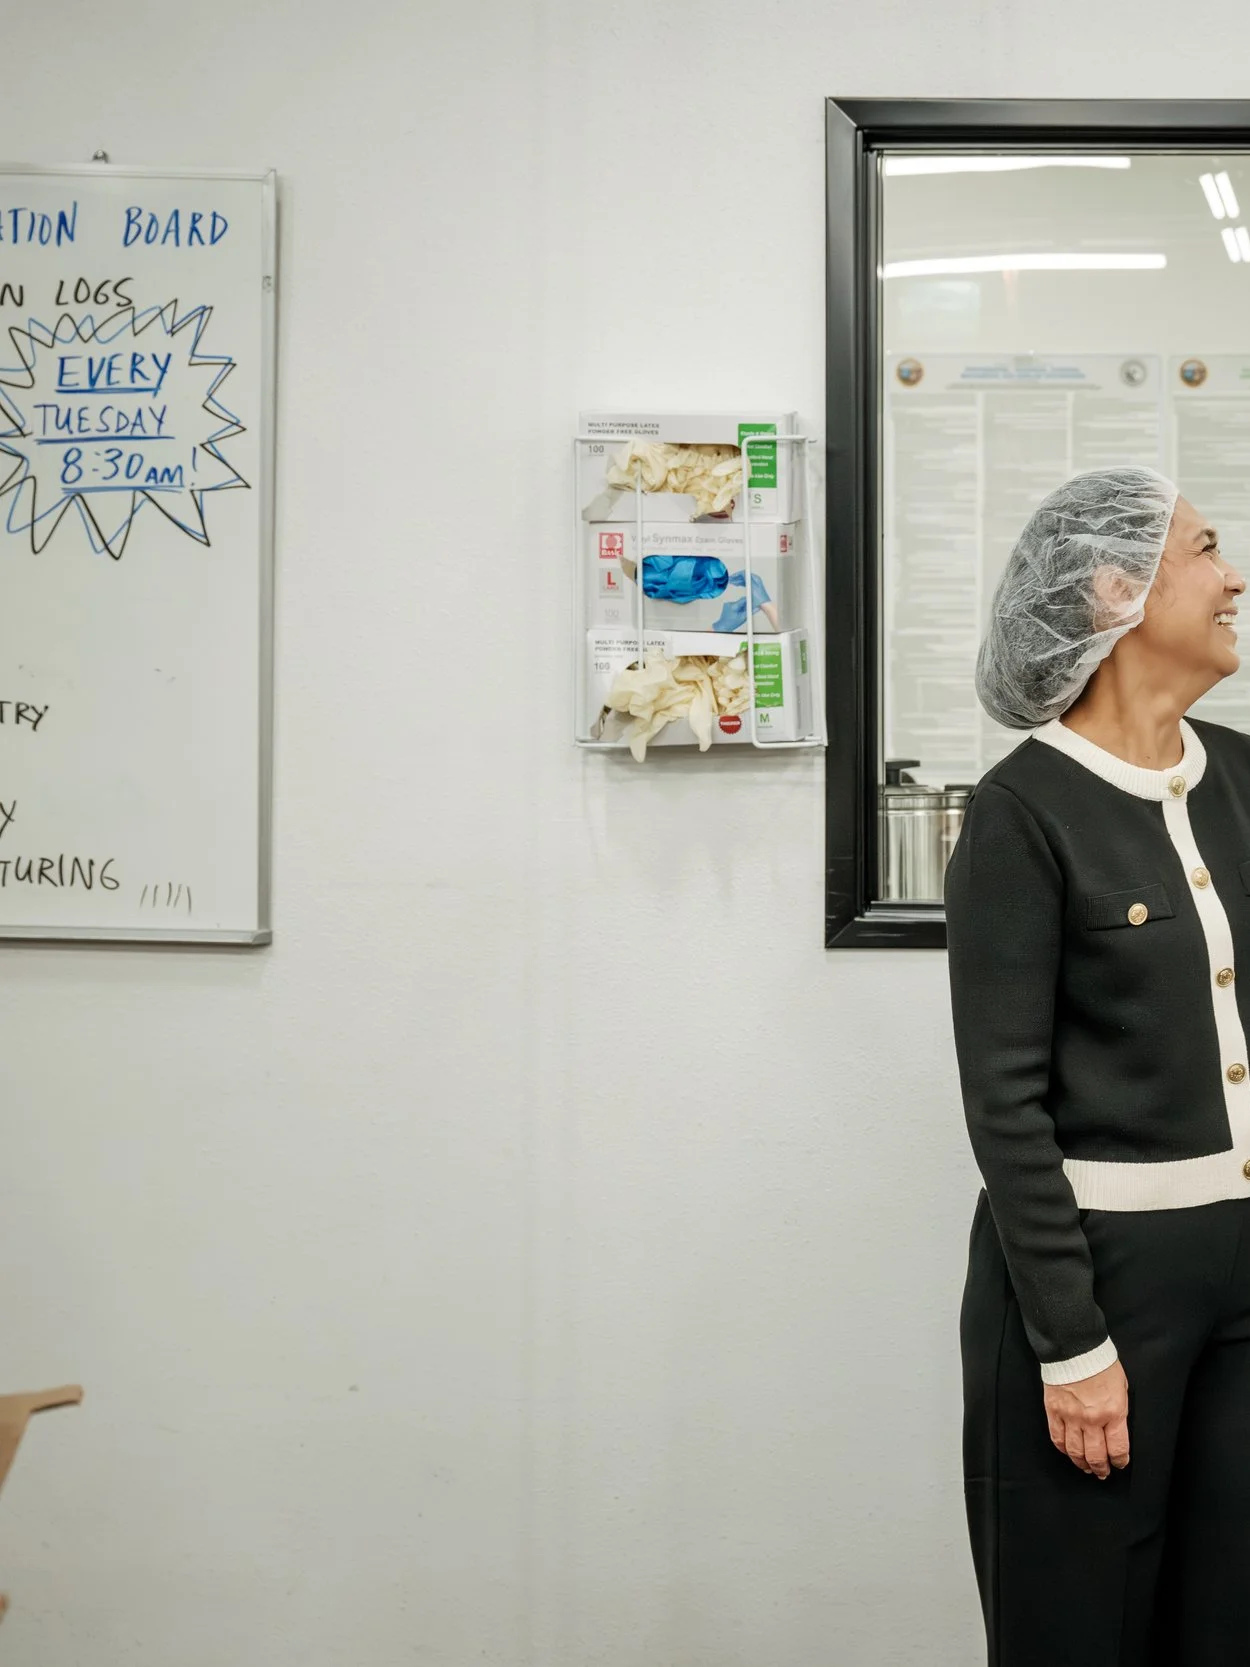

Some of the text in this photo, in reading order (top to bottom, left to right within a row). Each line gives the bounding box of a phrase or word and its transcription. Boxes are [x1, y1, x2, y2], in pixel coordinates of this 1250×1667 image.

[0, 200, 229, 247] TION BOARD
[55, 277, 134, 307] LOGS
[58, 353, 172, 398] EVERY
[33, 404, 167, 435] TUESDAY
[588, 445, 605, 453] 100
[754, 493, 762, 504] S
[652, 532, 693, 545] Synmax
[607, 571, 616, 585] L
[594, 662, 610, 671] 100
[0, 701, 49, 731] TRY
[760, 713, 769, 723] M
[0, 854, 120, 890] TURING
